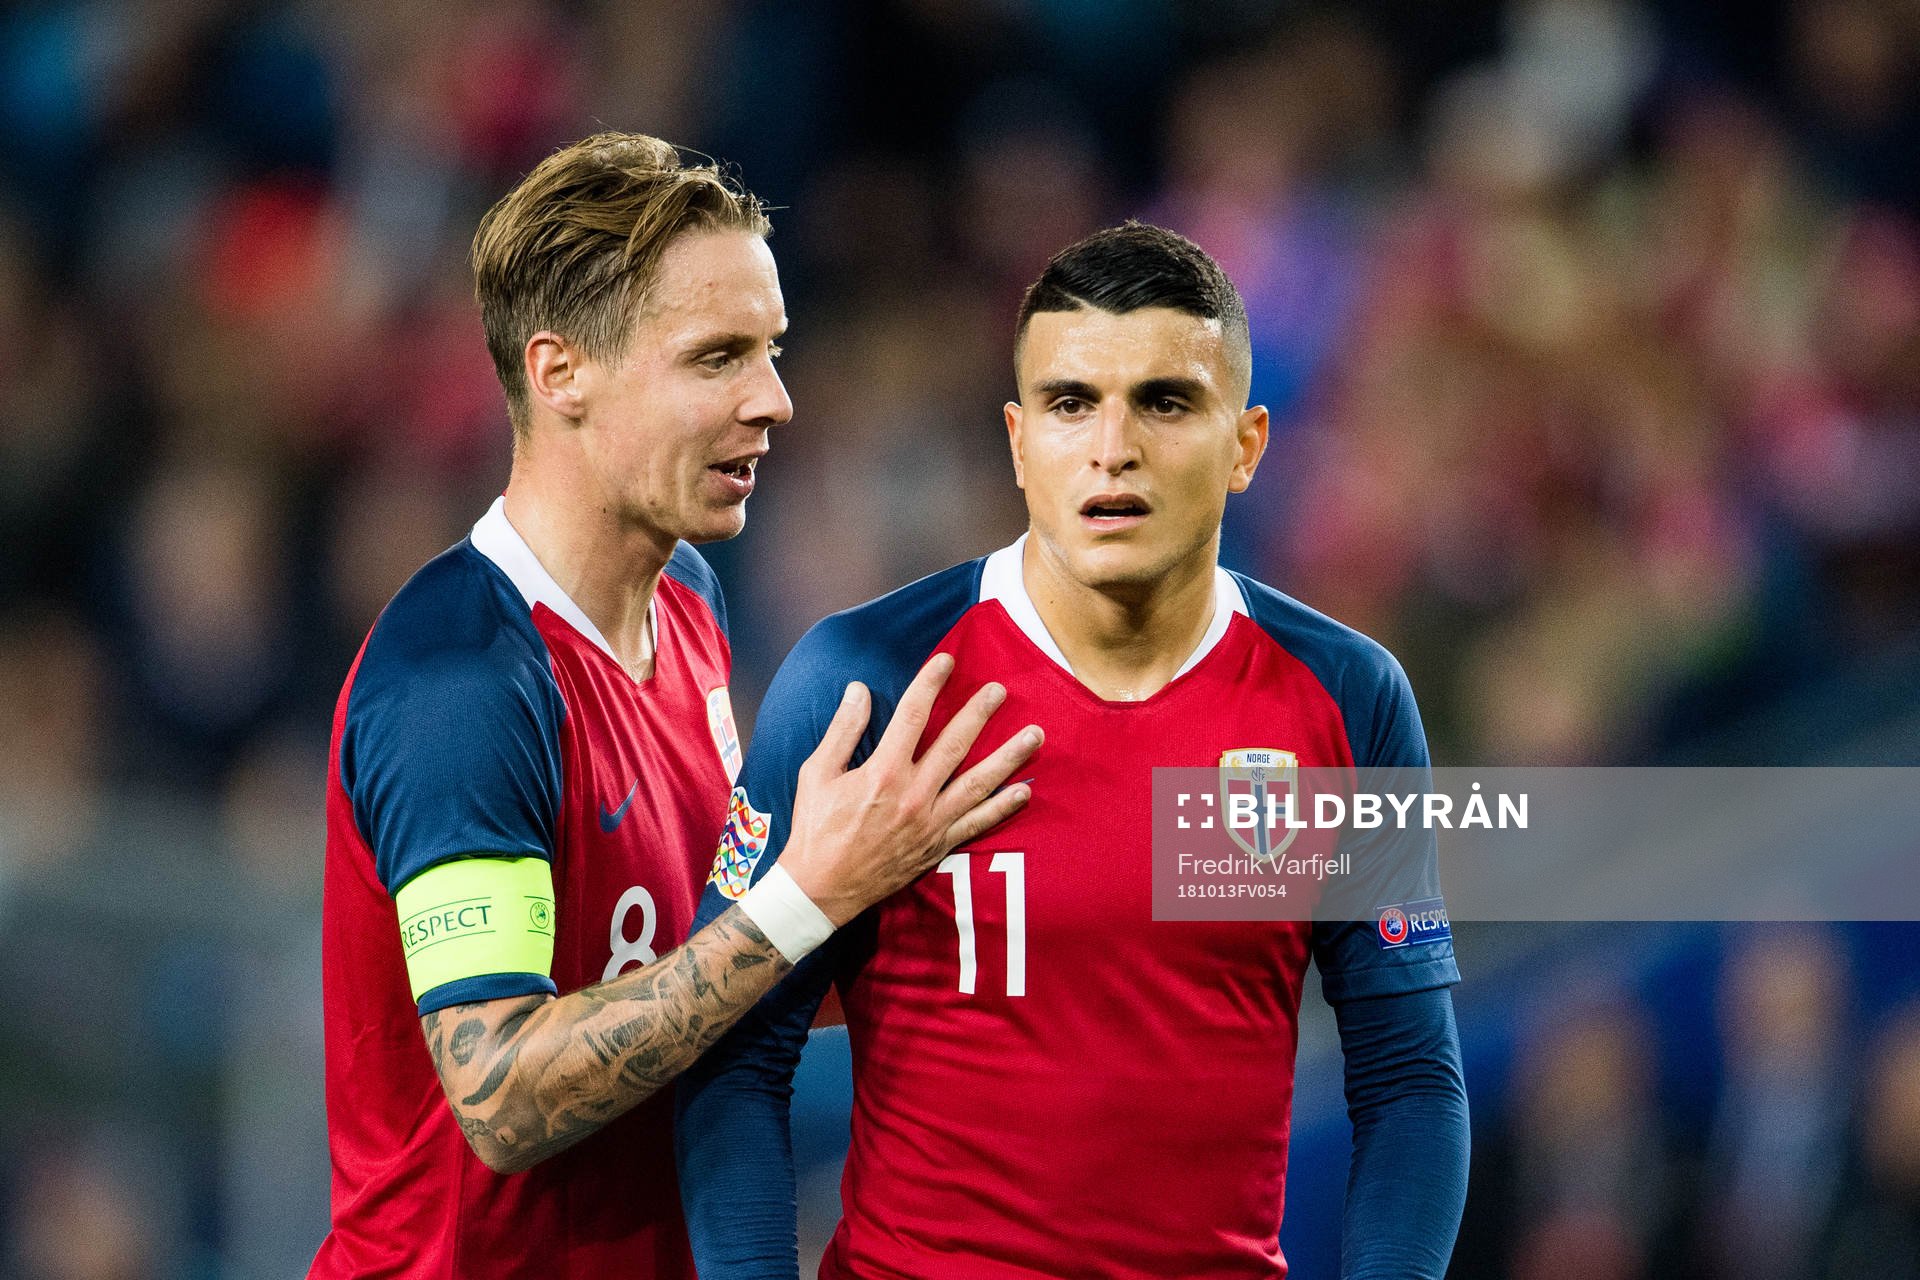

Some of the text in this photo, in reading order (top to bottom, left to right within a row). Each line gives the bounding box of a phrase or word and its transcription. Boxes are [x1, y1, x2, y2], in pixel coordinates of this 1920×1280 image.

[1246, 753, 1270, 764] NORGE
[401, 905, 492, 949] RESPECT
[600, 885, 658, 983] 8
[936, 852, 1025, 997] 11
